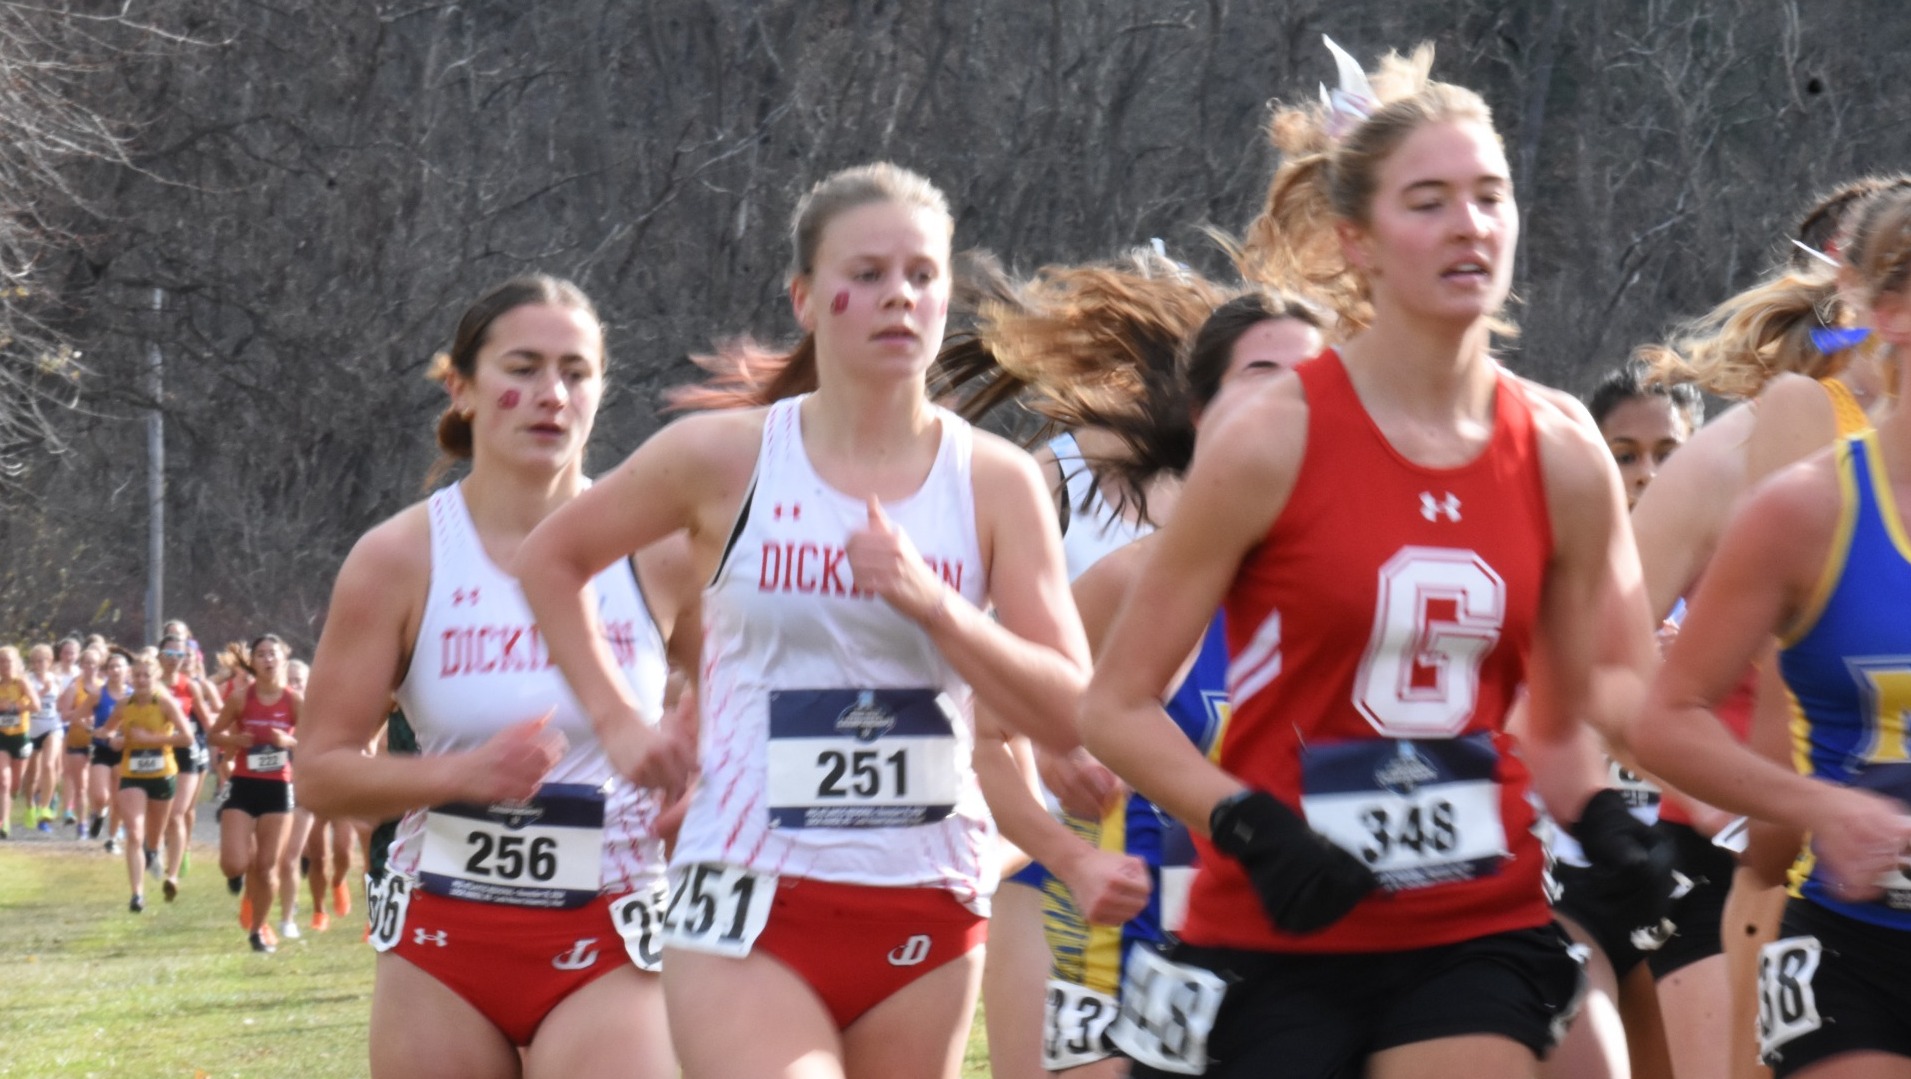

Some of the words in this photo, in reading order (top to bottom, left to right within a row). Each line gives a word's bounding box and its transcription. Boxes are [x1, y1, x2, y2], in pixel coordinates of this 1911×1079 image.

[1351, 544, 1508, 739] G
[816, 748, 908, 799] 251
[465, 831, 558, 881] 256
[1361, 799, 1461, 865] 348
